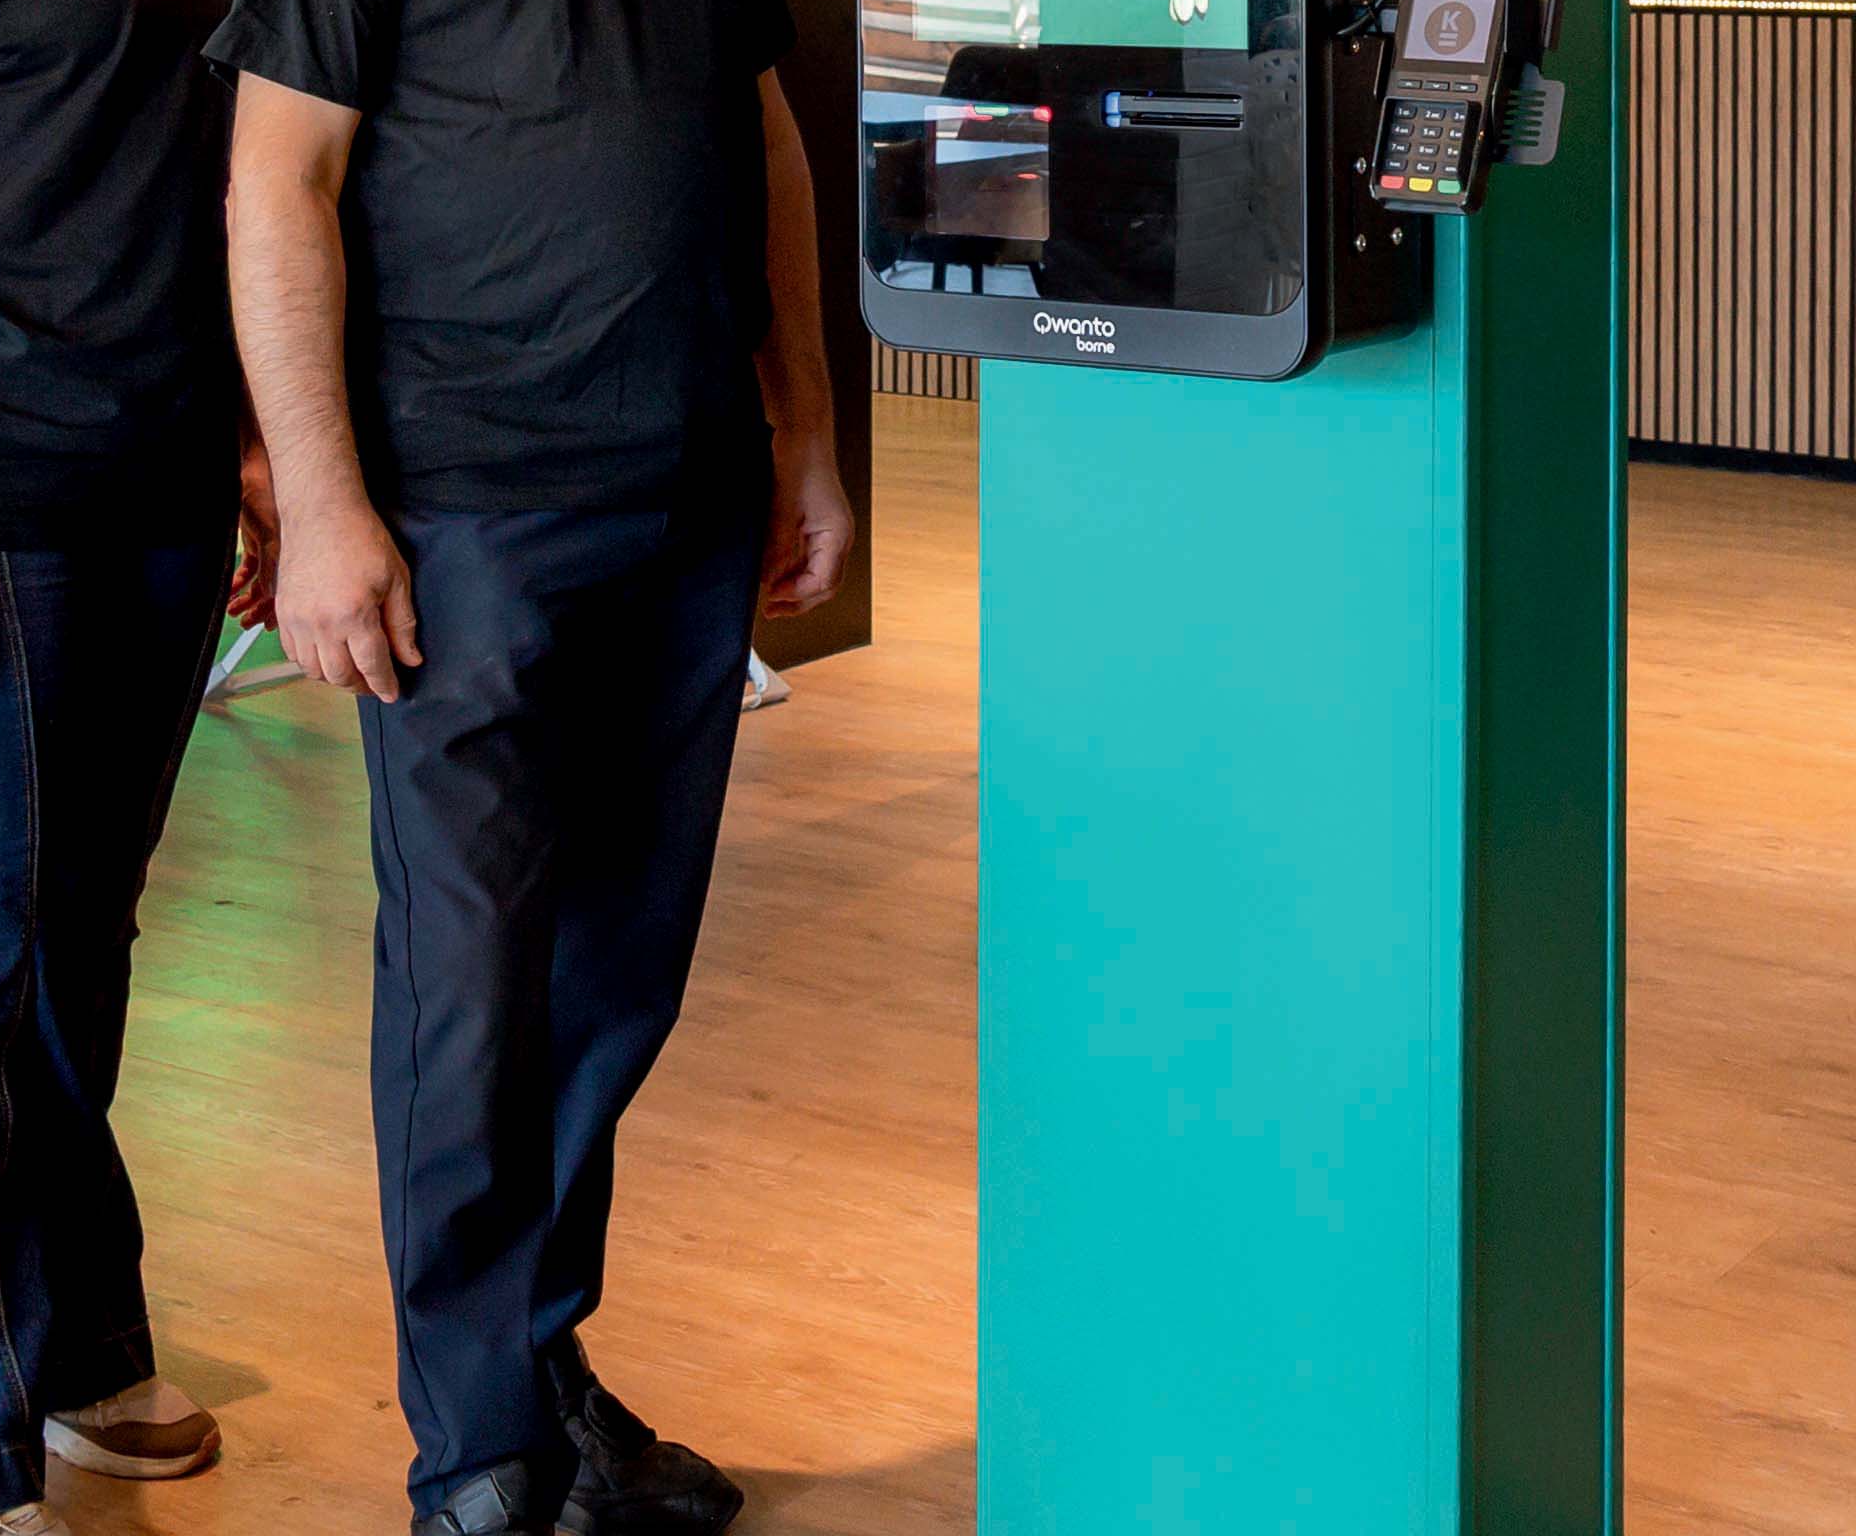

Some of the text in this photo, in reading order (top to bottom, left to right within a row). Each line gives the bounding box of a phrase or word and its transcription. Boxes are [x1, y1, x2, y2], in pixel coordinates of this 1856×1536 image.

[1441, 10, 1462, 32] K
[1033, 312, 1115, 337] Qwanto
[1076, 336, 1115, 354] borne
